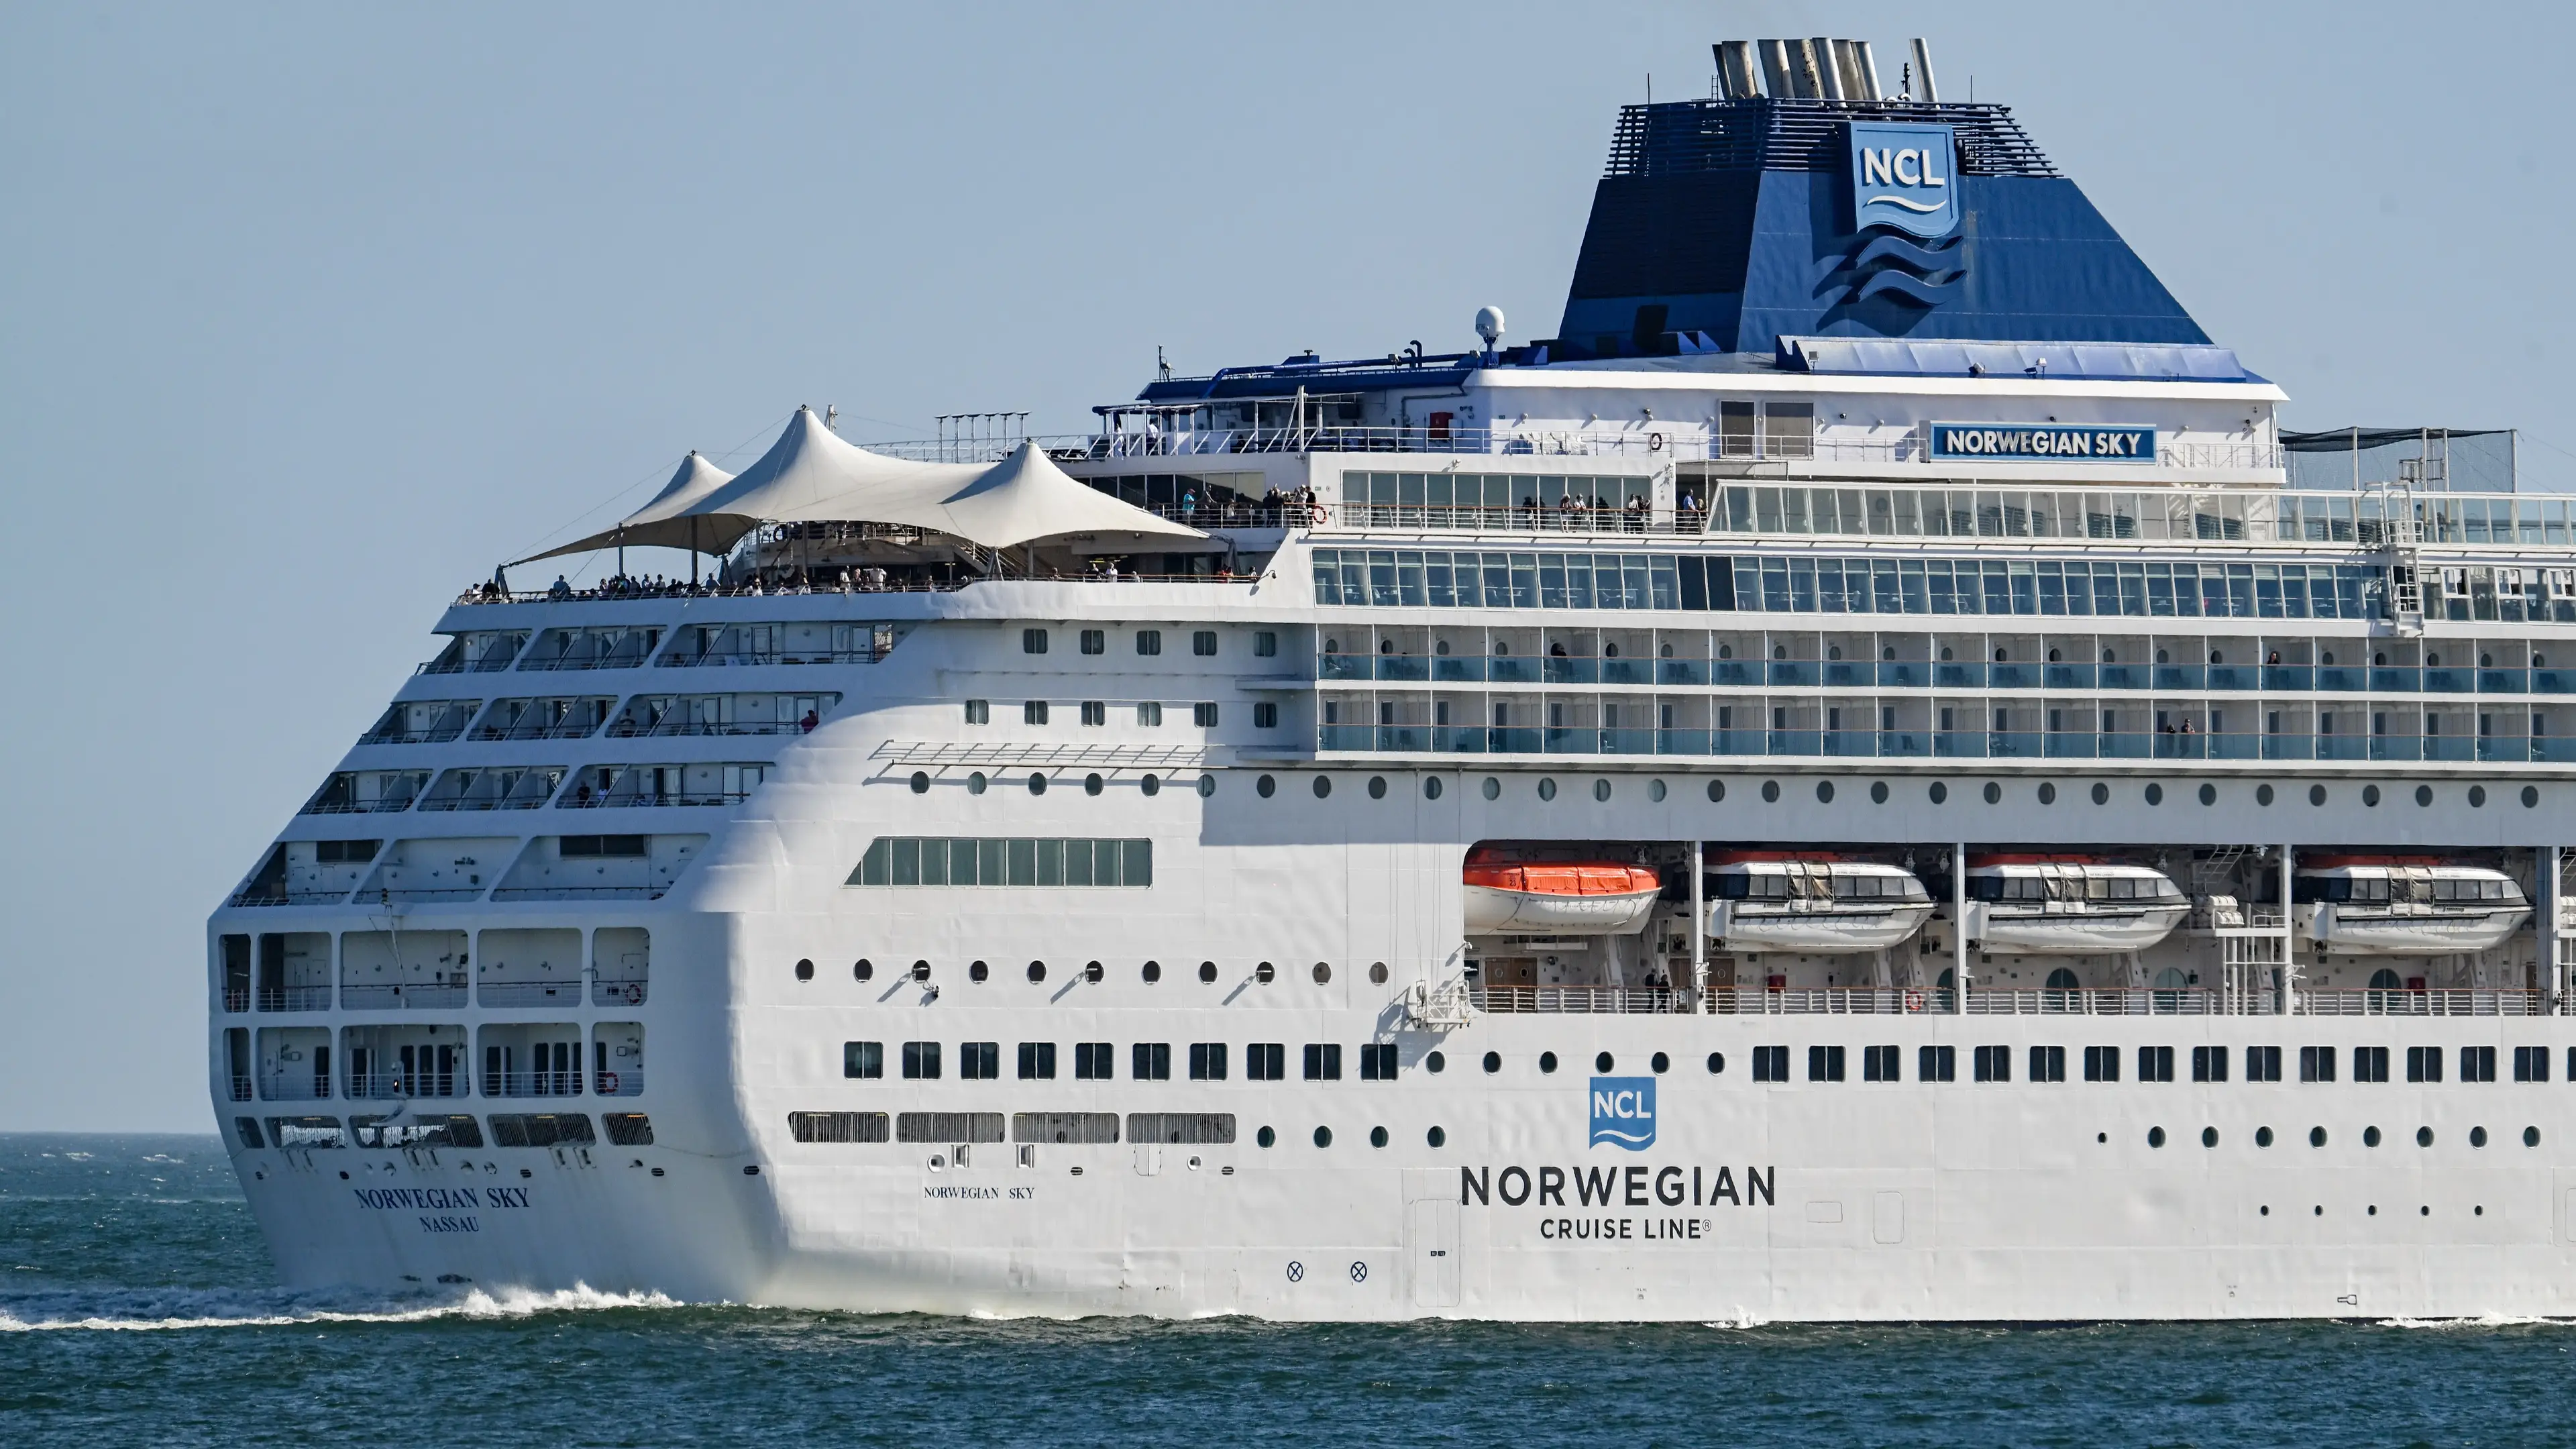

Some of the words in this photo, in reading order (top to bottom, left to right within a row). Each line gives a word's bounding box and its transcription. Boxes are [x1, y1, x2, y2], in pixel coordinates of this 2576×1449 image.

[1863, 147, 1945, 186] NCL
[1946, 429, 2090, 455] NORWEGIAN
[2095, 432, 2141, 455] SKY
[1509, 879, 1517, 887] 23
[1594, 1091, 1652, 1119] NCL
[924, 1186, 999, 1199] NORWEGIAN
[1009, 1187, 1035, 1199] SKY
[1461, 1165, 1775, 1207] NORWEGIAN
[354, 1188, 480, 1209] NORWEGIAN
[486, 1187, 531, 1208] SKY
[419, 1216, 480, 1232] NASSAU
[1540, 1218, 1632, 1240] CRUISE
